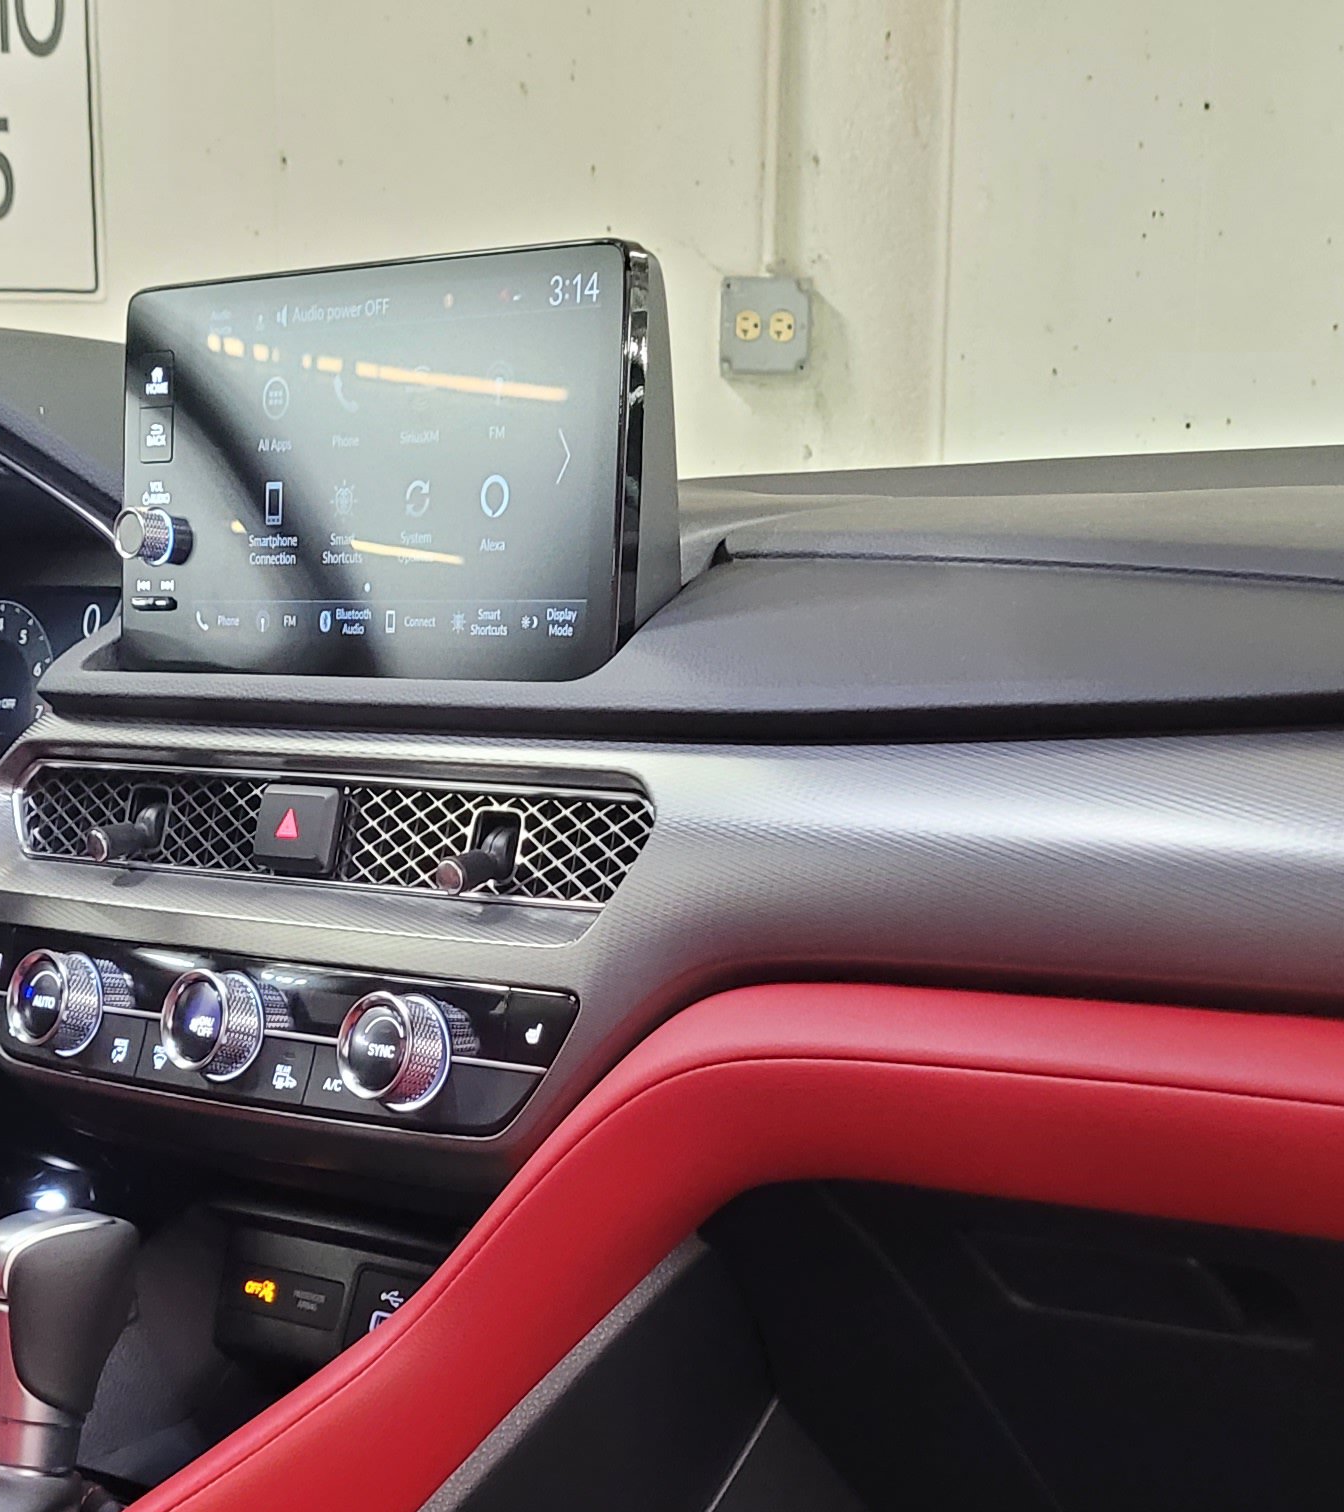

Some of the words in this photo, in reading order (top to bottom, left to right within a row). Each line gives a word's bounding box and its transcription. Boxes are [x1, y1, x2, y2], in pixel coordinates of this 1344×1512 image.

[549, 272, 600, 306] 3:14
[292, 306, 324, 323] Audio
[326, 303, 361, 325] power
[364, 299, 390, 316] OFF
[145, 381, 169, 395] HOME
[146, 433, 167, 447] BACK
[488, 426, 506, 439] FM
[258, 438, 270, 452] All
[271, 438, 293, 454] Apps
[332, 434, 360, 448] Phone
[248, 533, 299, 549] Smartphone
[330, 532, 355, 546] Smart
[400, 531, 432, 547] System
[479, 538, 506, 552] Alexa
[249, 552, 297, 566] Connection
[322, 550, 363, 565] Shortcuts
[217, 614, 240, 628] Phone
[283, 614, 297, 628] FM
[335, 607, 372, 622] Bluetooth
[404, 615, 436, 628] Connect
[477, 608, 502, 622] Smart
[546, 607, 578, 624] Display
[342, 621, 365, 636] Audio
[470, 622, 508, 637] Shortcuts
[548, 622, 574, 638] Mode
[18, 629, 28, 645] 5
[32, 662, 42, 678] 6
[31, 995, 56, 1010] AUTO
[197, 1026, 214, 1038] OFF
[367, 1043, 396, 1059] SYNC
[322, 1077, 343, 1092] A/C
